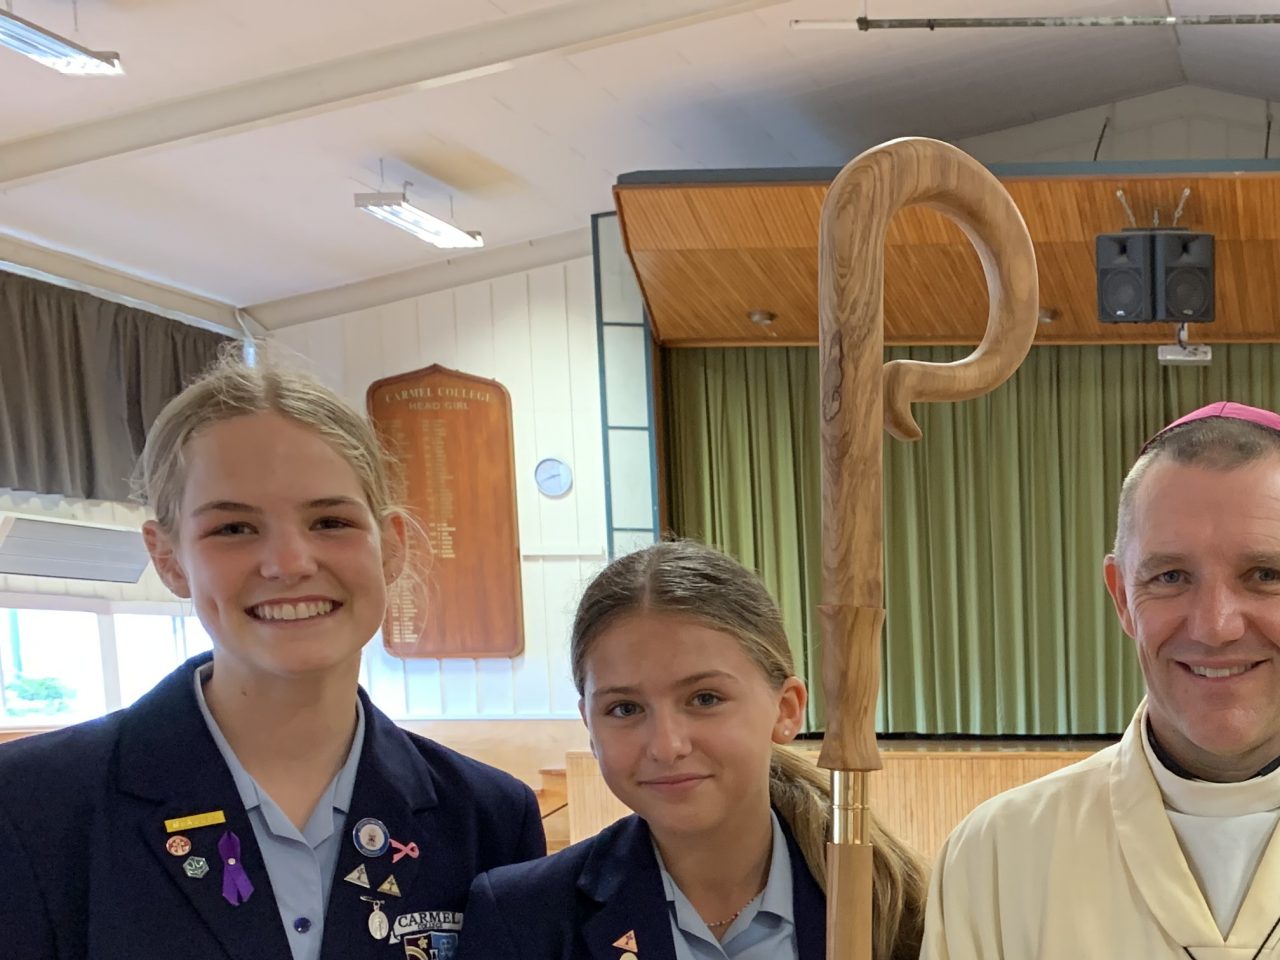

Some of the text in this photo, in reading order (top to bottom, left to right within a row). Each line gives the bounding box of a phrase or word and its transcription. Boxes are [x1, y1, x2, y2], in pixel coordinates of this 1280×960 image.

[385, 386, 432, 402] CARMEL
[408, 401, 469, 411] HEAD GIRL
[398, 911, 461, 928] CARMEL
